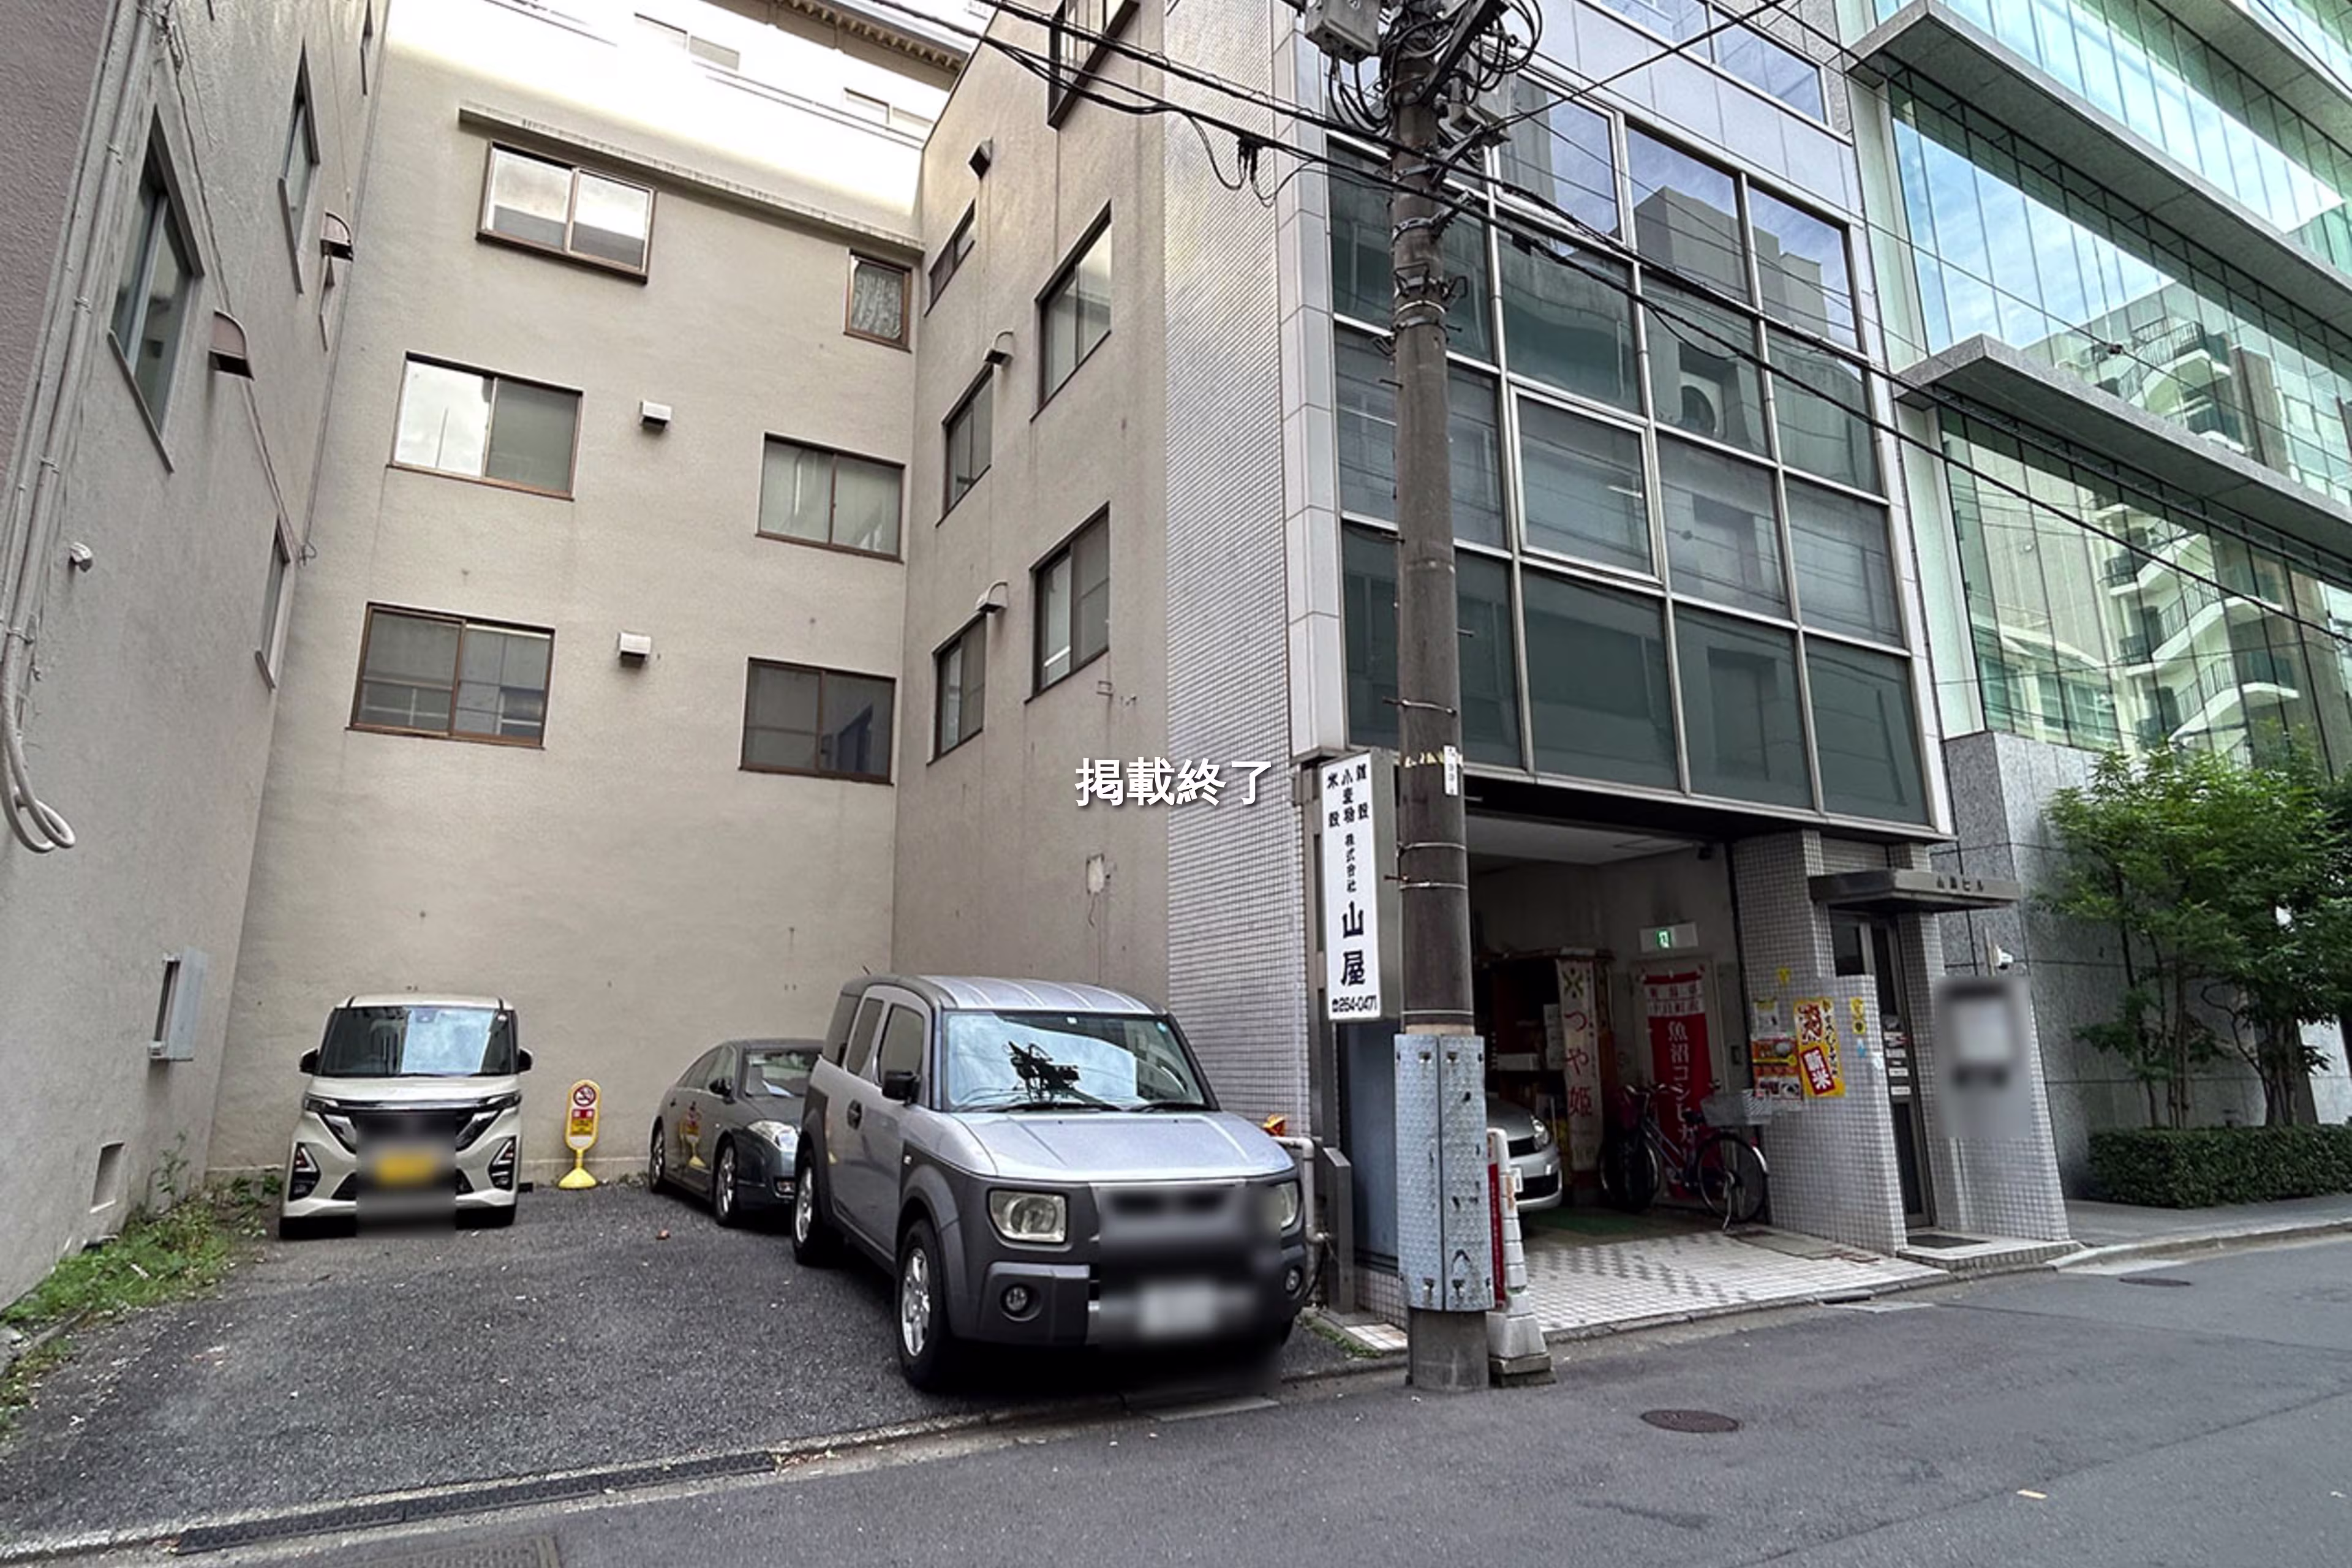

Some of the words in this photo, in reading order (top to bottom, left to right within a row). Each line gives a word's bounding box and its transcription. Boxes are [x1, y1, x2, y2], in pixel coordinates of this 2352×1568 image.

[1341, 900, 1365, 986] 山屋
[1565, 1011, 1593, 1117] つや姫
